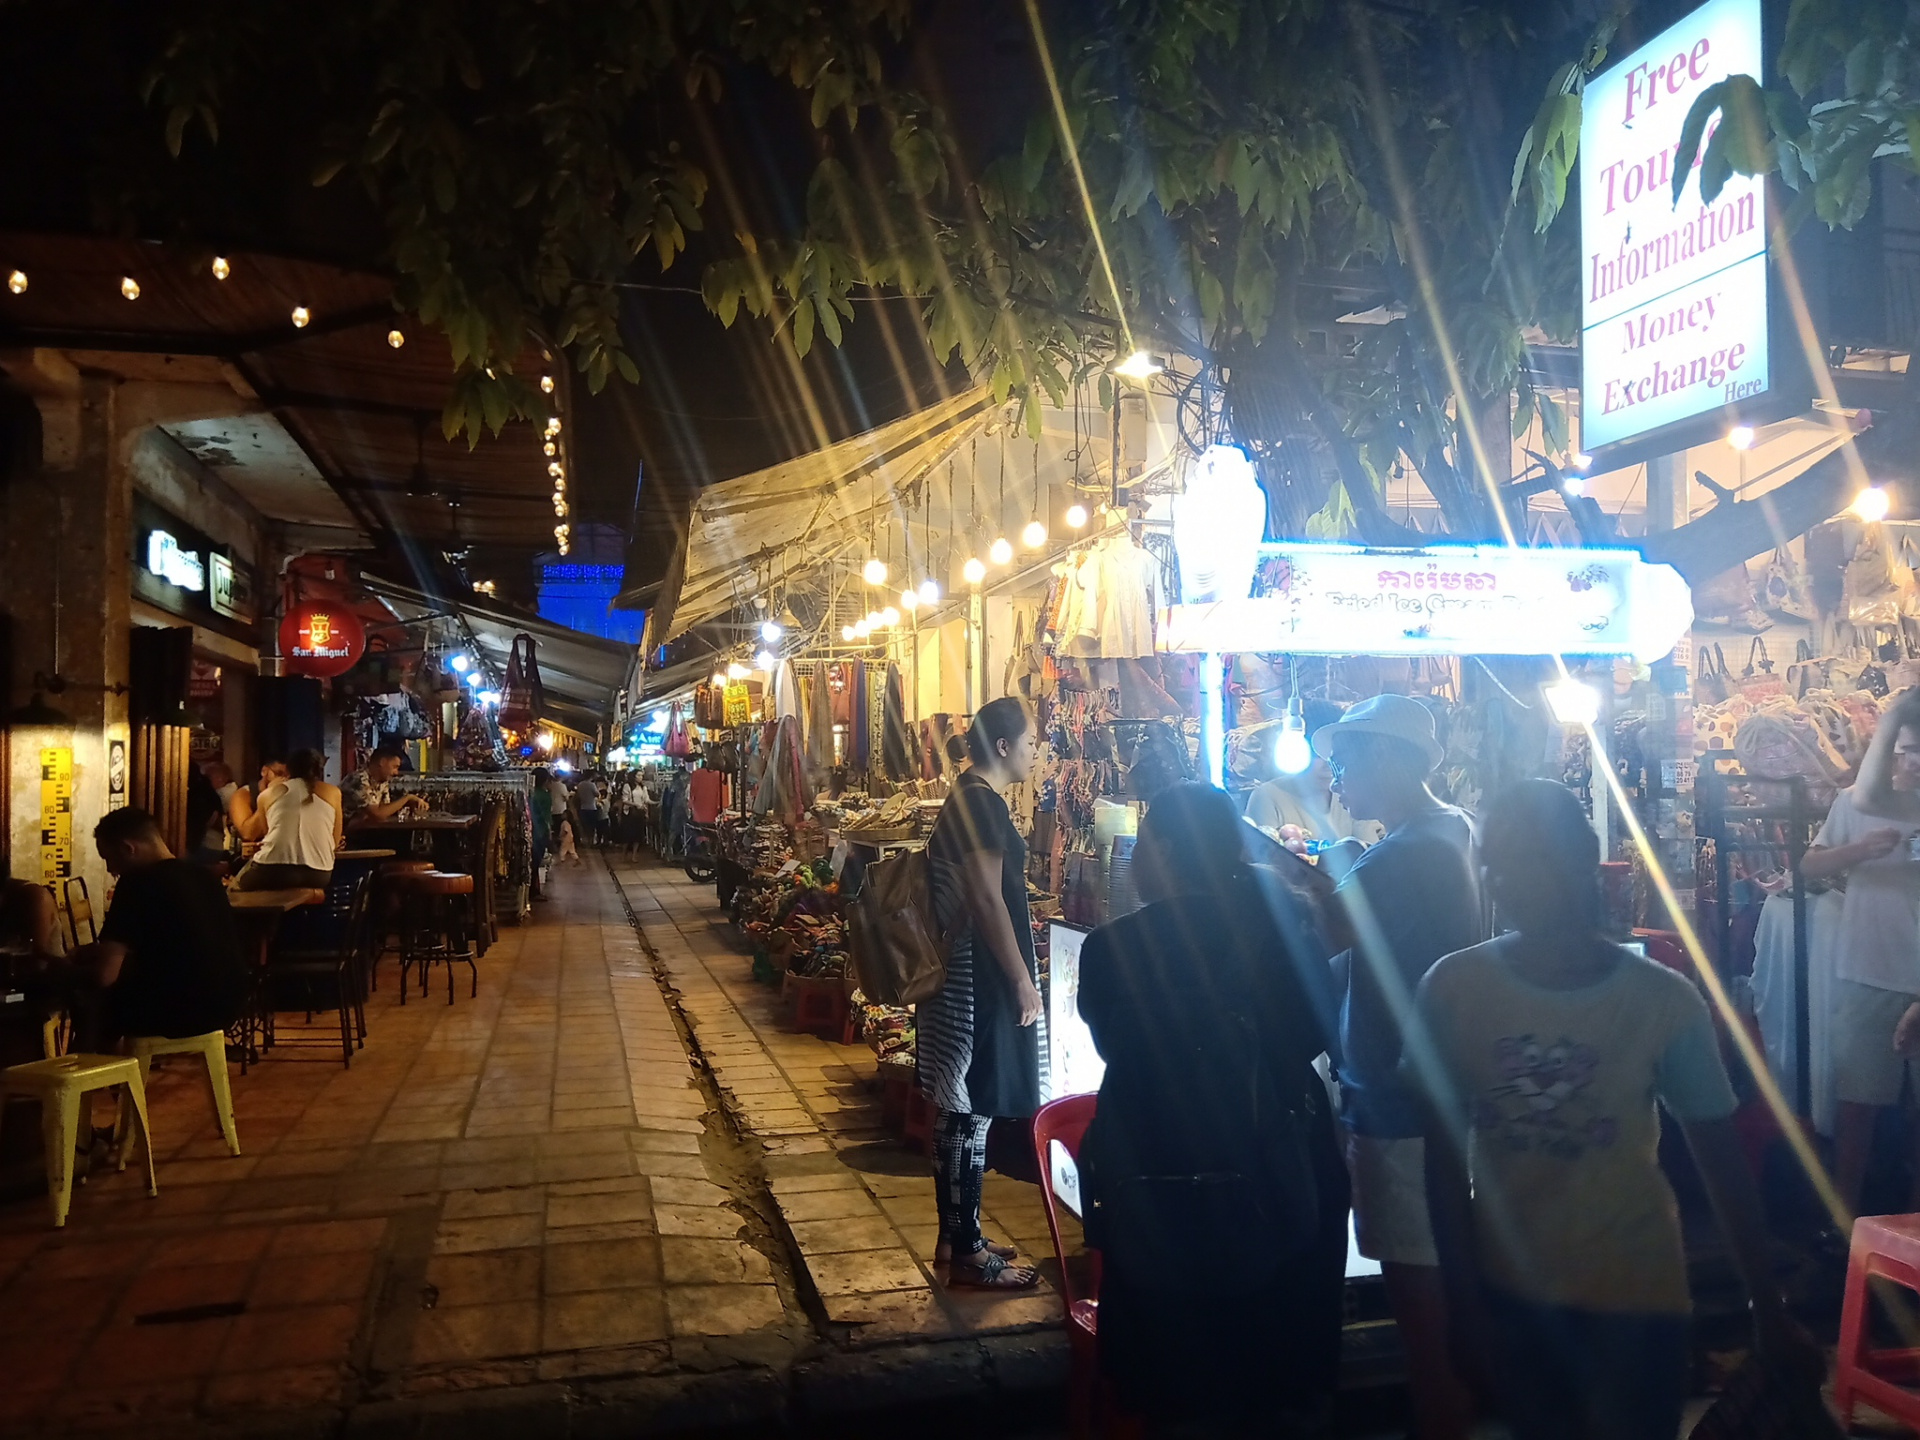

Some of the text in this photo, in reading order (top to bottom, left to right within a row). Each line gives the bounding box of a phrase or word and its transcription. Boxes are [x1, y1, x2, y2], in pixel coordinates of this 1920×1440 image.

[1621, 37, 1710, 125] Free
[1589, 191, 1755, 304] Information
[1622, 291, 1722, 355] Money
[1601, 342, 1746, 416] Exchange
[1723, 377, 1762, 404] Here
[292, 645, 349, 659] San Miguel
